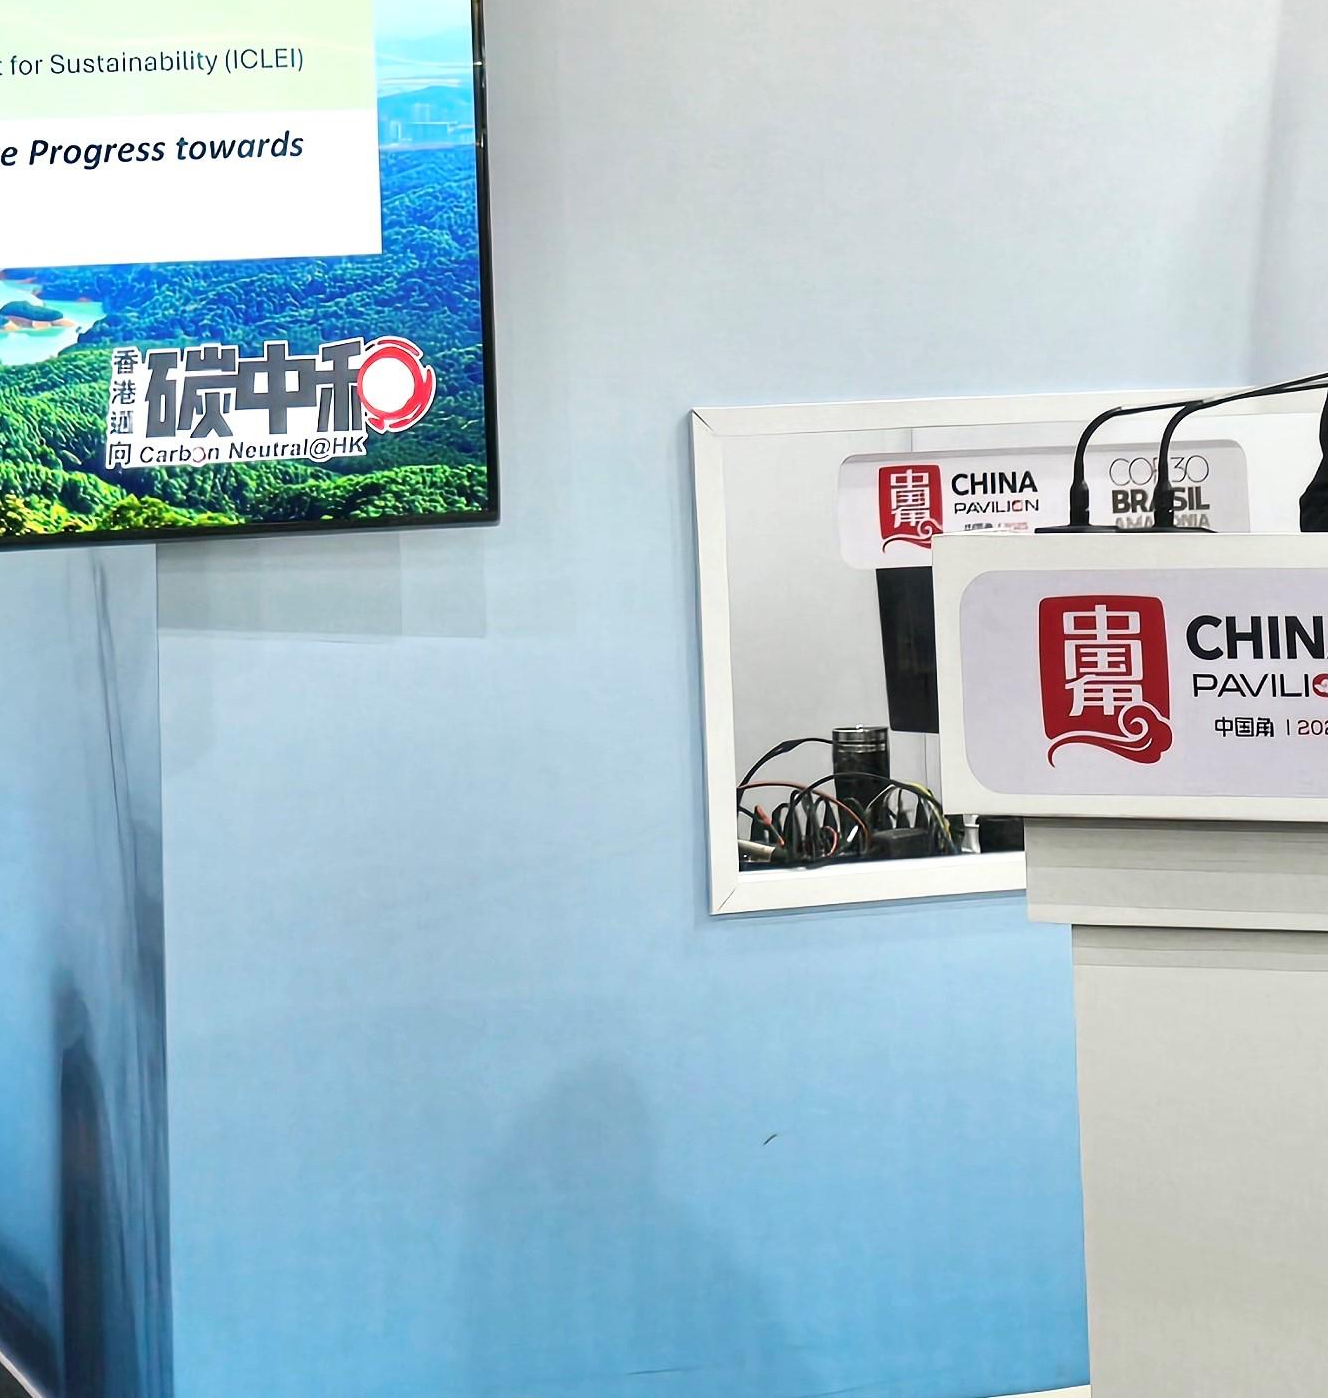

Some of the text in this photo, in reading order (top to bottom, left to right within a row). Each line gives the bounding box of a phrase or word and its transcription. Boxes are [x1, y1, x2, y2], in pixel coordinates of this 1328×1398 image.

[10, 56, 43, 76] for
[50, 51, 217, 75] Sustainability
[225, 48, 303, 73] (ICLEI)
[29, 137, 165, 170] Progress
[176, 131, 303, 161] towards
[140, 436, 366, 464] Carbon Neutral@HK
[951, 471, 1038, 496] CHINA
[954, 500, 1039, 514] PAVILION
[1062, 604, 1143, 717] 中国角
[1214, 717, 1275, 738] 中国角
